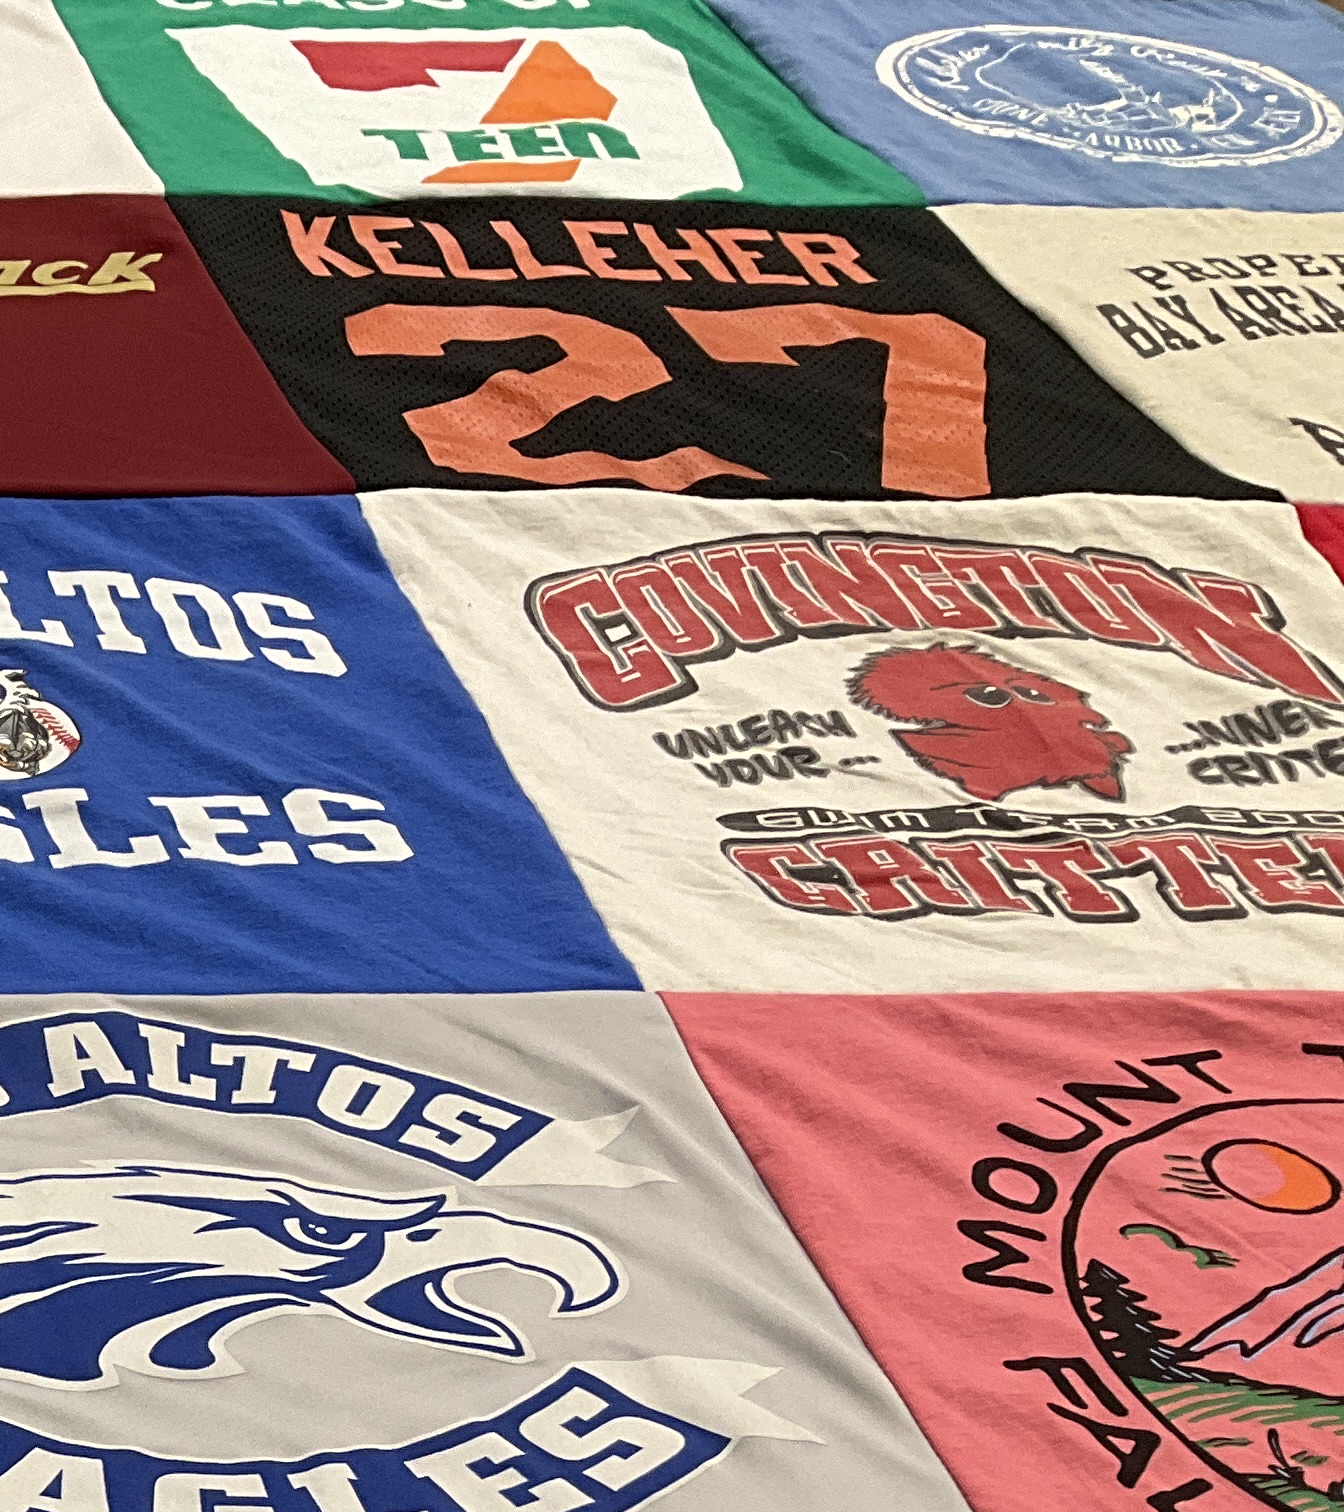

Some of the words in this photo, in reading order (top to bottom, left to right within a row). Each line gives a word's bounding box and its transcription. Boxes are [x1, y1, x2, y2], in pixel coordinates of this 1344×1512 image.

[279, 207, 880, 287] KELLEHER
[1095, 293, 1227, 360] BAY
[343, 303, 992, 498] 27
[524, 530, 1344, 713] COVINGTON
[652, 708, 858, 760] UNLEASH
[755, 808, 931, 831] SWIM
[43, 1018, 522, 1178] ALTOS
[955, 1048, 1234, 1295] MOUNT
